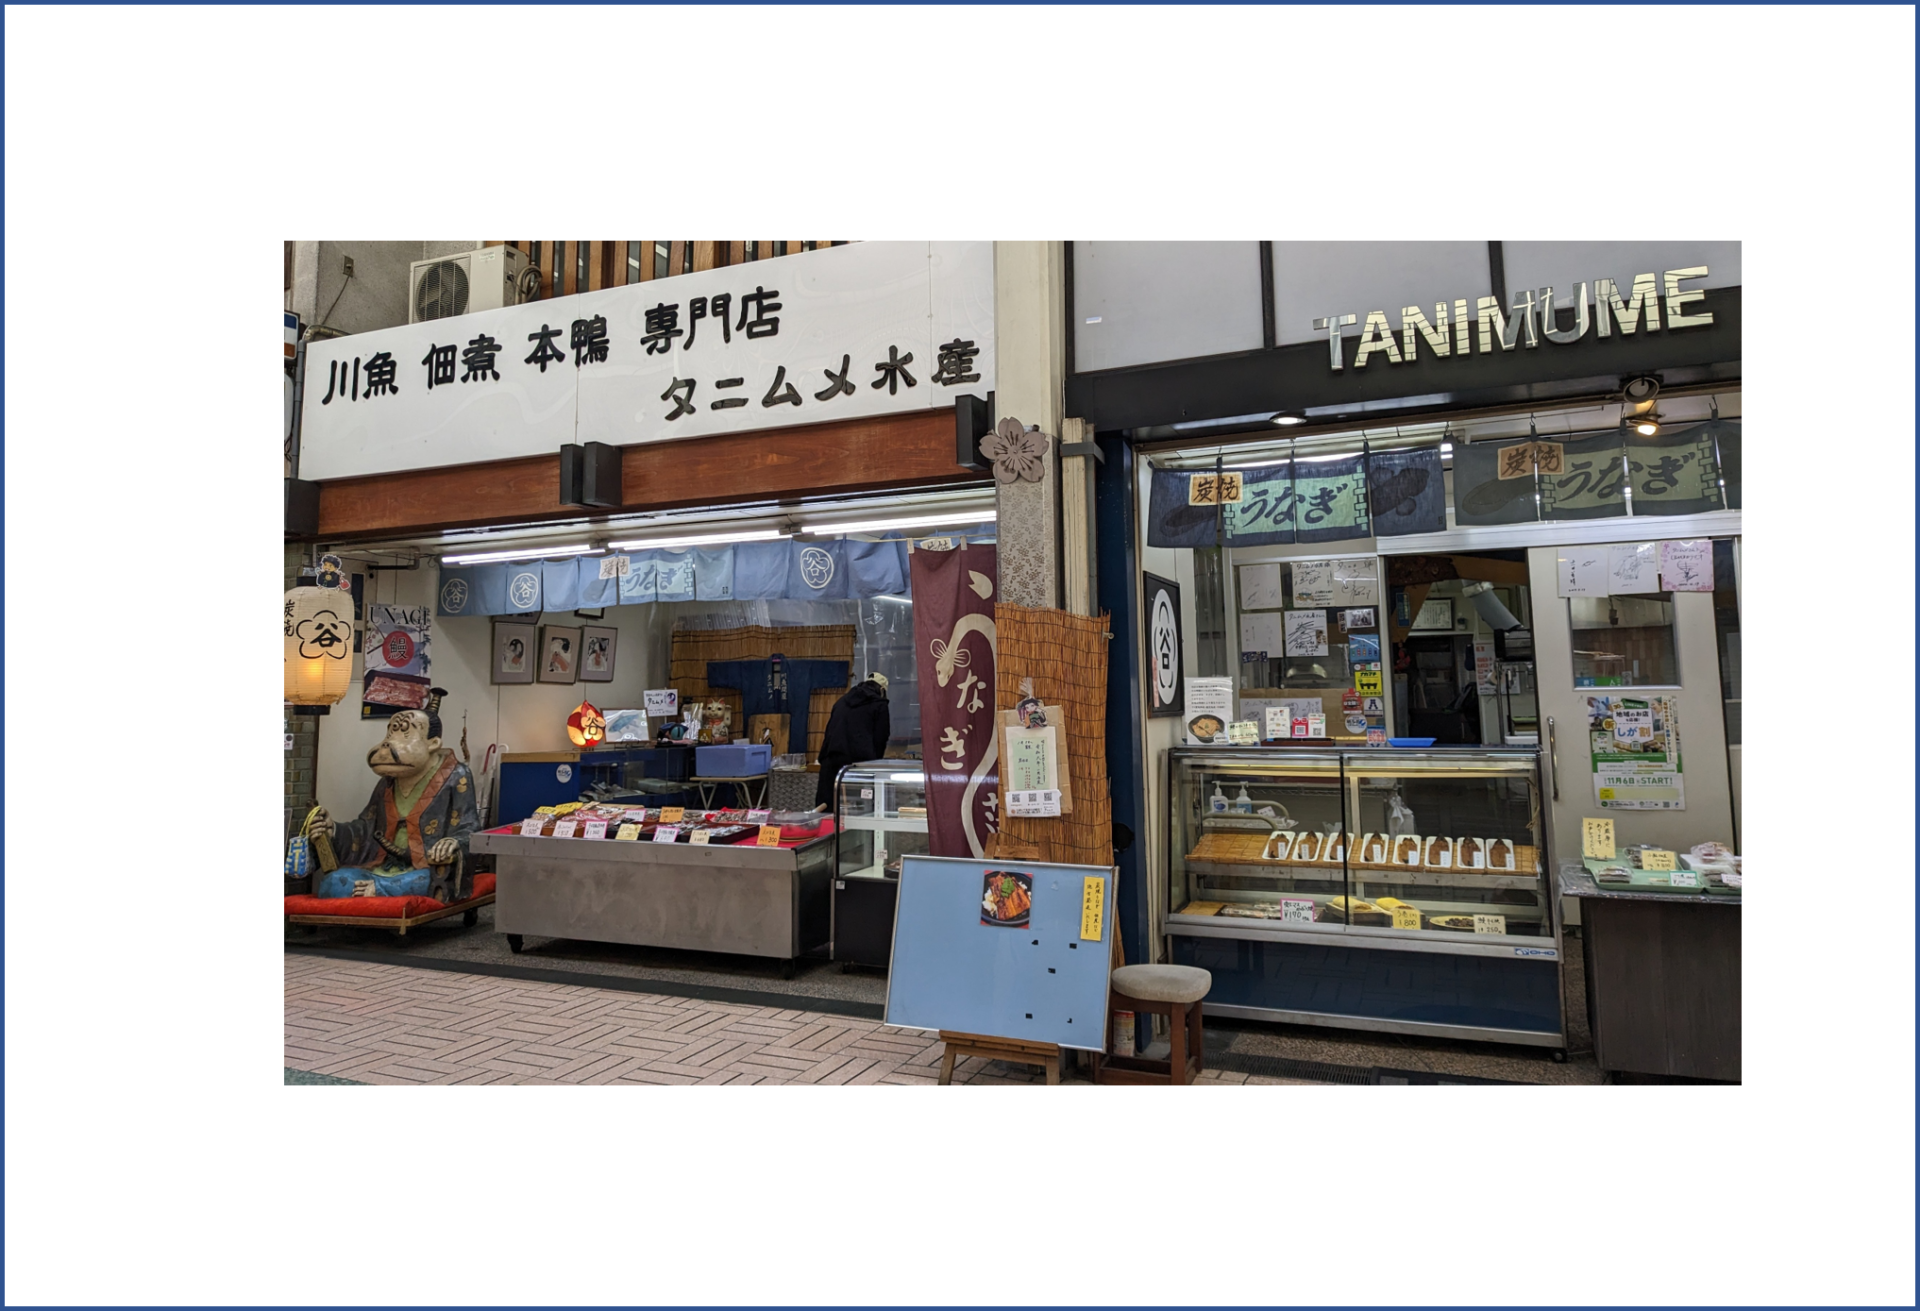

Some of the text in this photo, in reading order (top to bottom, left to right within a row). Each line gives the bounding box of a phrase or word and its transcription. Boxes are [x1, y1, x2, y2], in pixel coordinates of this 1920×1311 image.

[1313, 265, 1714, 371] TANIMUME
[321, 286, 783, 405] 川魚 佃煮 本鴨 専門店
[660, 337, 981, 422] タニムメ水産
[1503, 446, 1561, 475] 炭焼
[1193, 475, 1240, 503] 炭焼
[1556, 451, 1696, 502] うなぎ
[1240, 482, 1349, 528] うなぎ
[602, 557, 628, 578] 炭焼
[625, 564, 684, 593] うなぎ
[369, 606, 428, 627] UNAGI
[310, 622, 343, 648] 谷
[387, 636, 408, 660] 鰻
[1159, 625, 1171, 670] 谷
[585, 718, 605, 736] 谷
